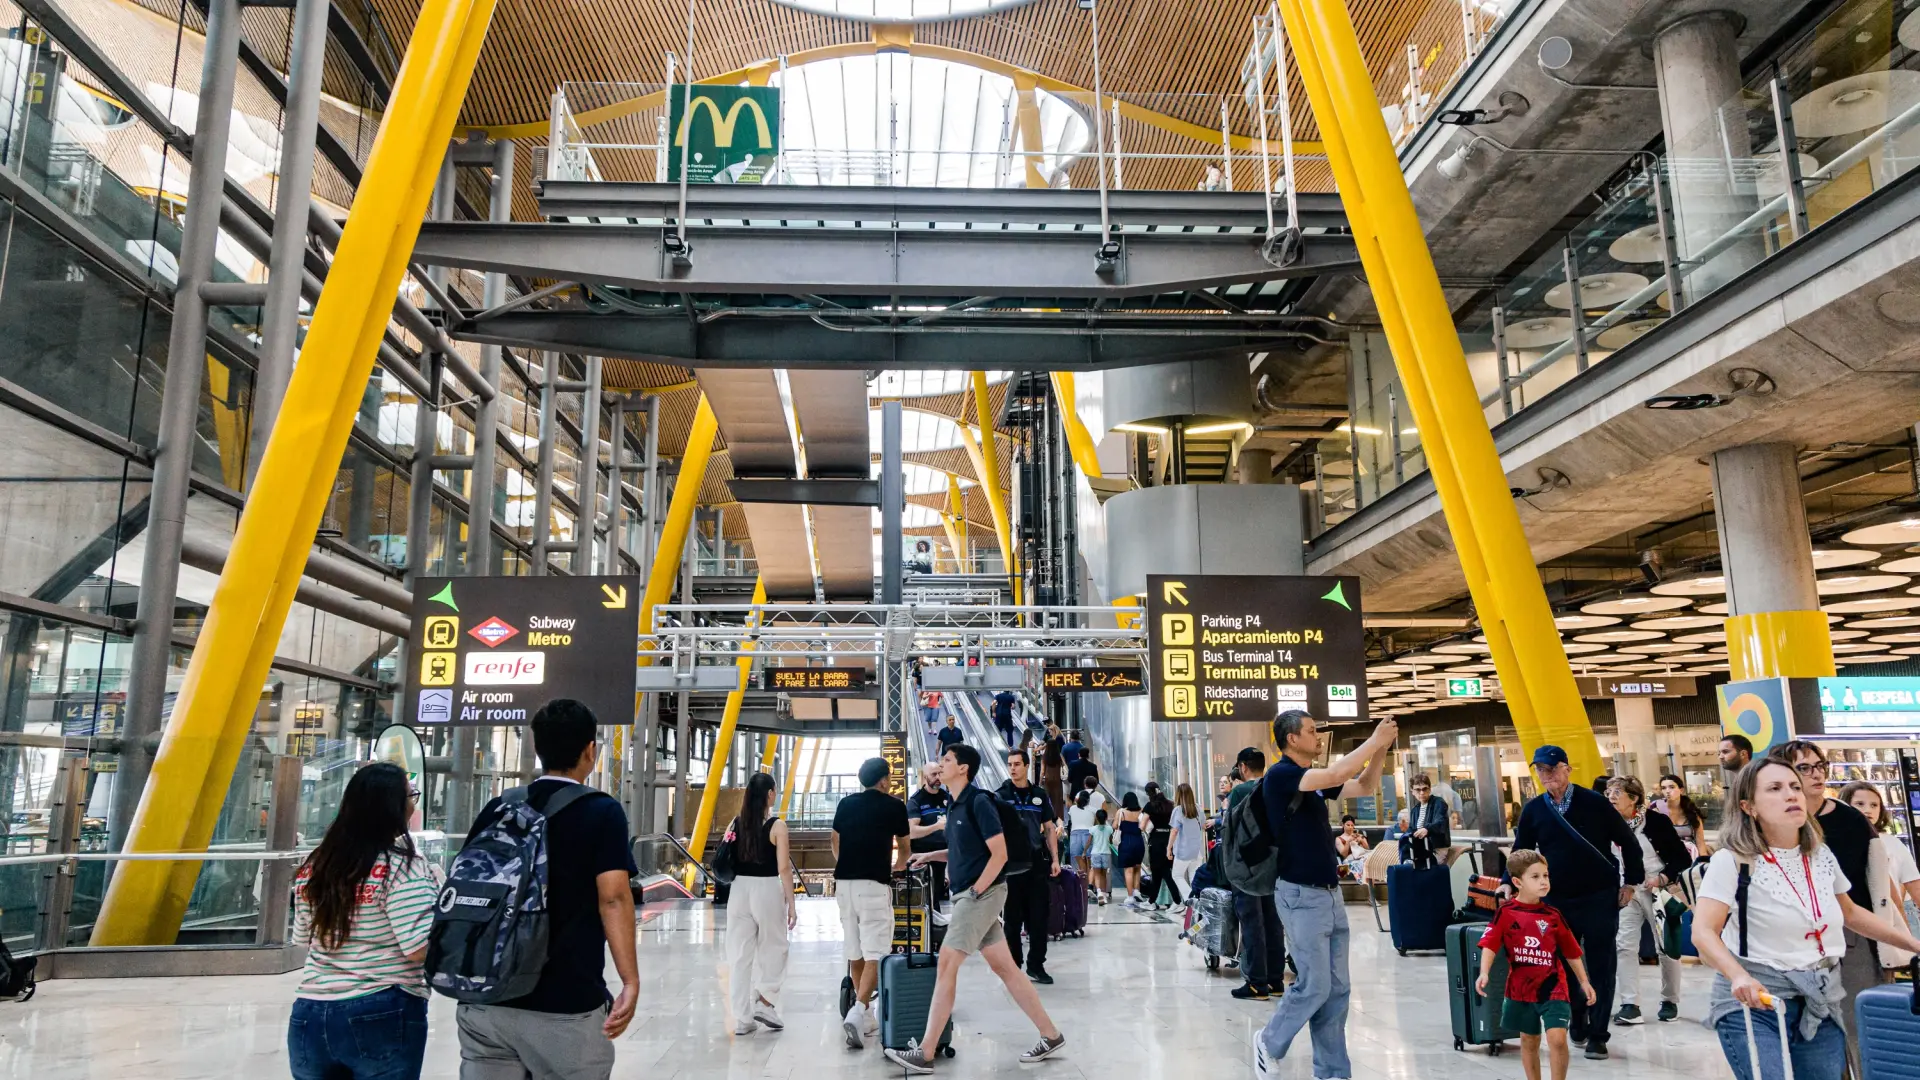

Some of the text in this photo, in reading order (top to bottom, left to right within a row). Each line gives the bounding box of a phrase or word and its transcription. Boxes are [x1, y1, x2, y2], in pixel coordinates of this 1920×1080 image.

[530, 616, 576, 630] Subway
[1202, 615, 1261, 629] Parking P4
[1170, 620, 1186, 640] P
[528, 632, 572, 646] Metro
[1202, 630, 1324, 646] Aparcamiento P4
[1203, 650, 1292, 662] Bus Terminal T4
[474, 656, 536, 679] renfe
[1203, 665, 1319, 679] Terminal Bus T4
[1044, 674, 1082, 686] HERE
[462, 690, 513, 703] Air room
[1204, 686, 1268, 700] Ridesharing
[1280, 688, 1304, 697] Uber
[1332, 686, 1352, 696] Bolt
[1860, 690, 1914, 704] DESPEGA
[460, 706, 526, 720] Air room
[1204, 702, 1234, 716] VTC
[1458, 788, 1476, 800] PAUL
[1514, 946, 1552, 958] MIRANDA
[1515, 956, 1552, 966] EMPRESAS
